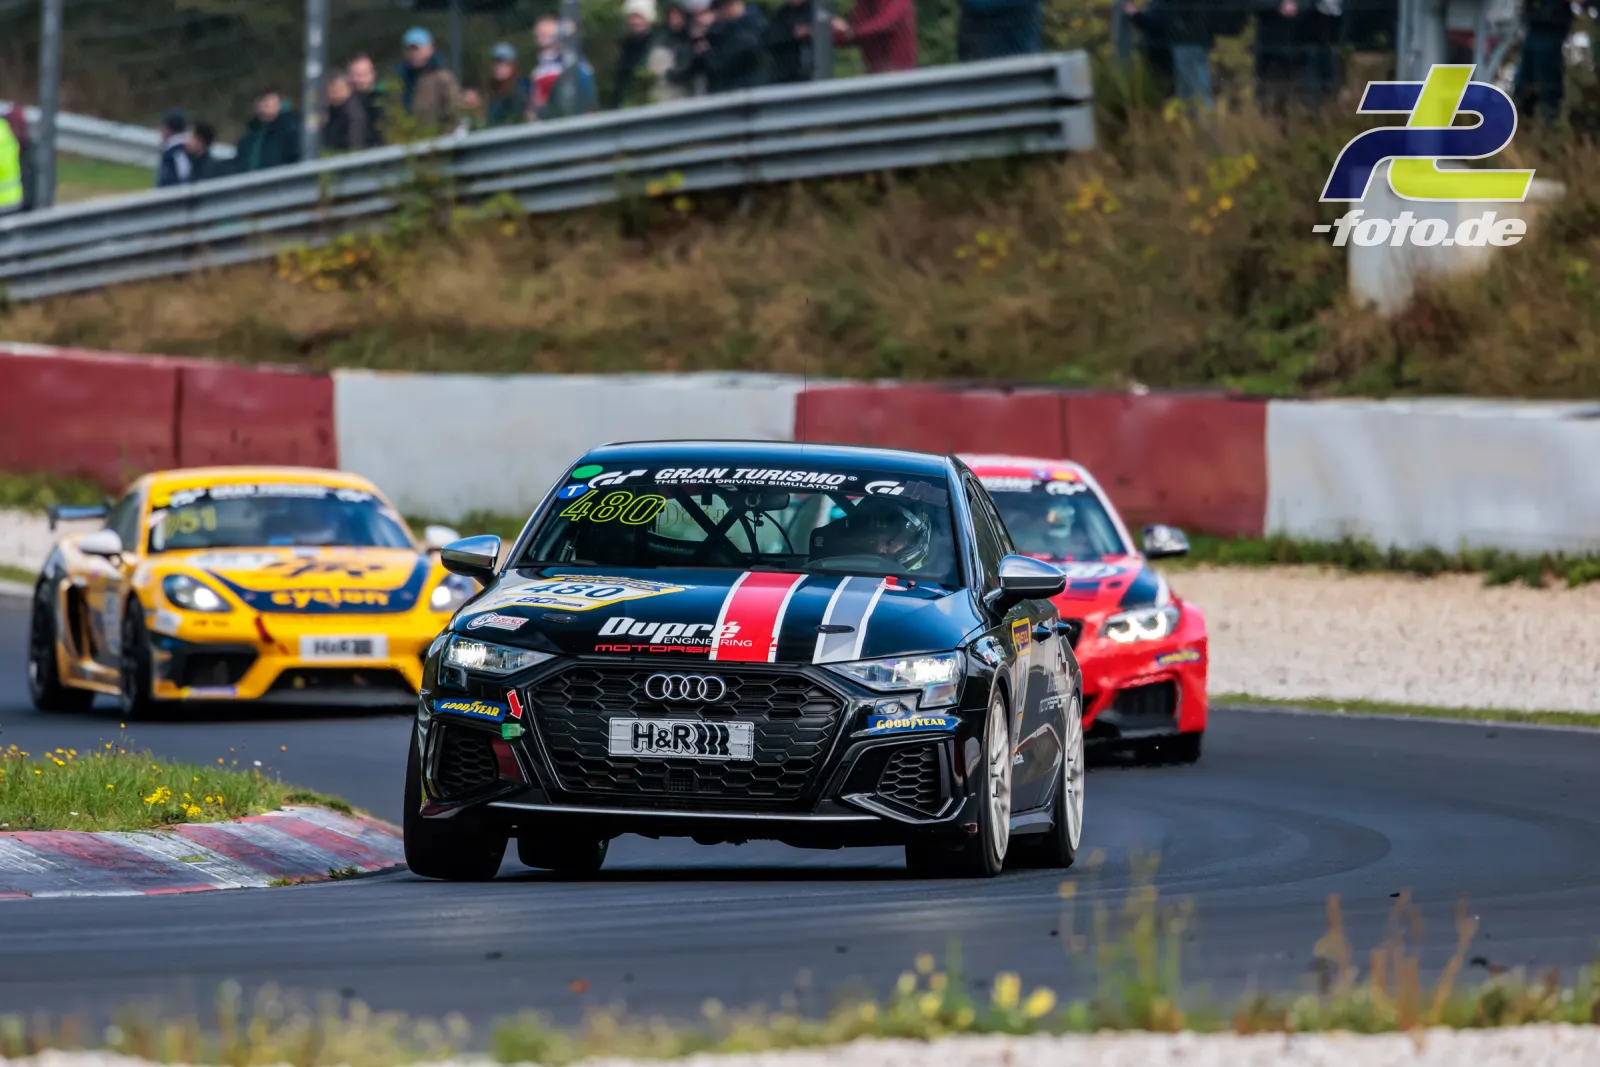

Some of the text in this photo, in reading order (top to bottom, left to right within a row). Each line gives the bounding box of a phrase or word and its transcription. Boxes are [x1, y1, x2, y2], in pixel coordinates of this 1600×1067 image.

[654, 468, 730, 480] GRAN
[567, 484, 583, 497] T
[768, 480, 839, 490] SIMULATOR
[559, 489, 667, 526] 480
[523, 582, 625, 599] 480
[663, 636, 753, 648] ENGINERING
[441, 700, 501, 717] GOODYEAR
[876, 715, 947, 729] GOODYEAR
[631, 721, 698, 754] H&R
